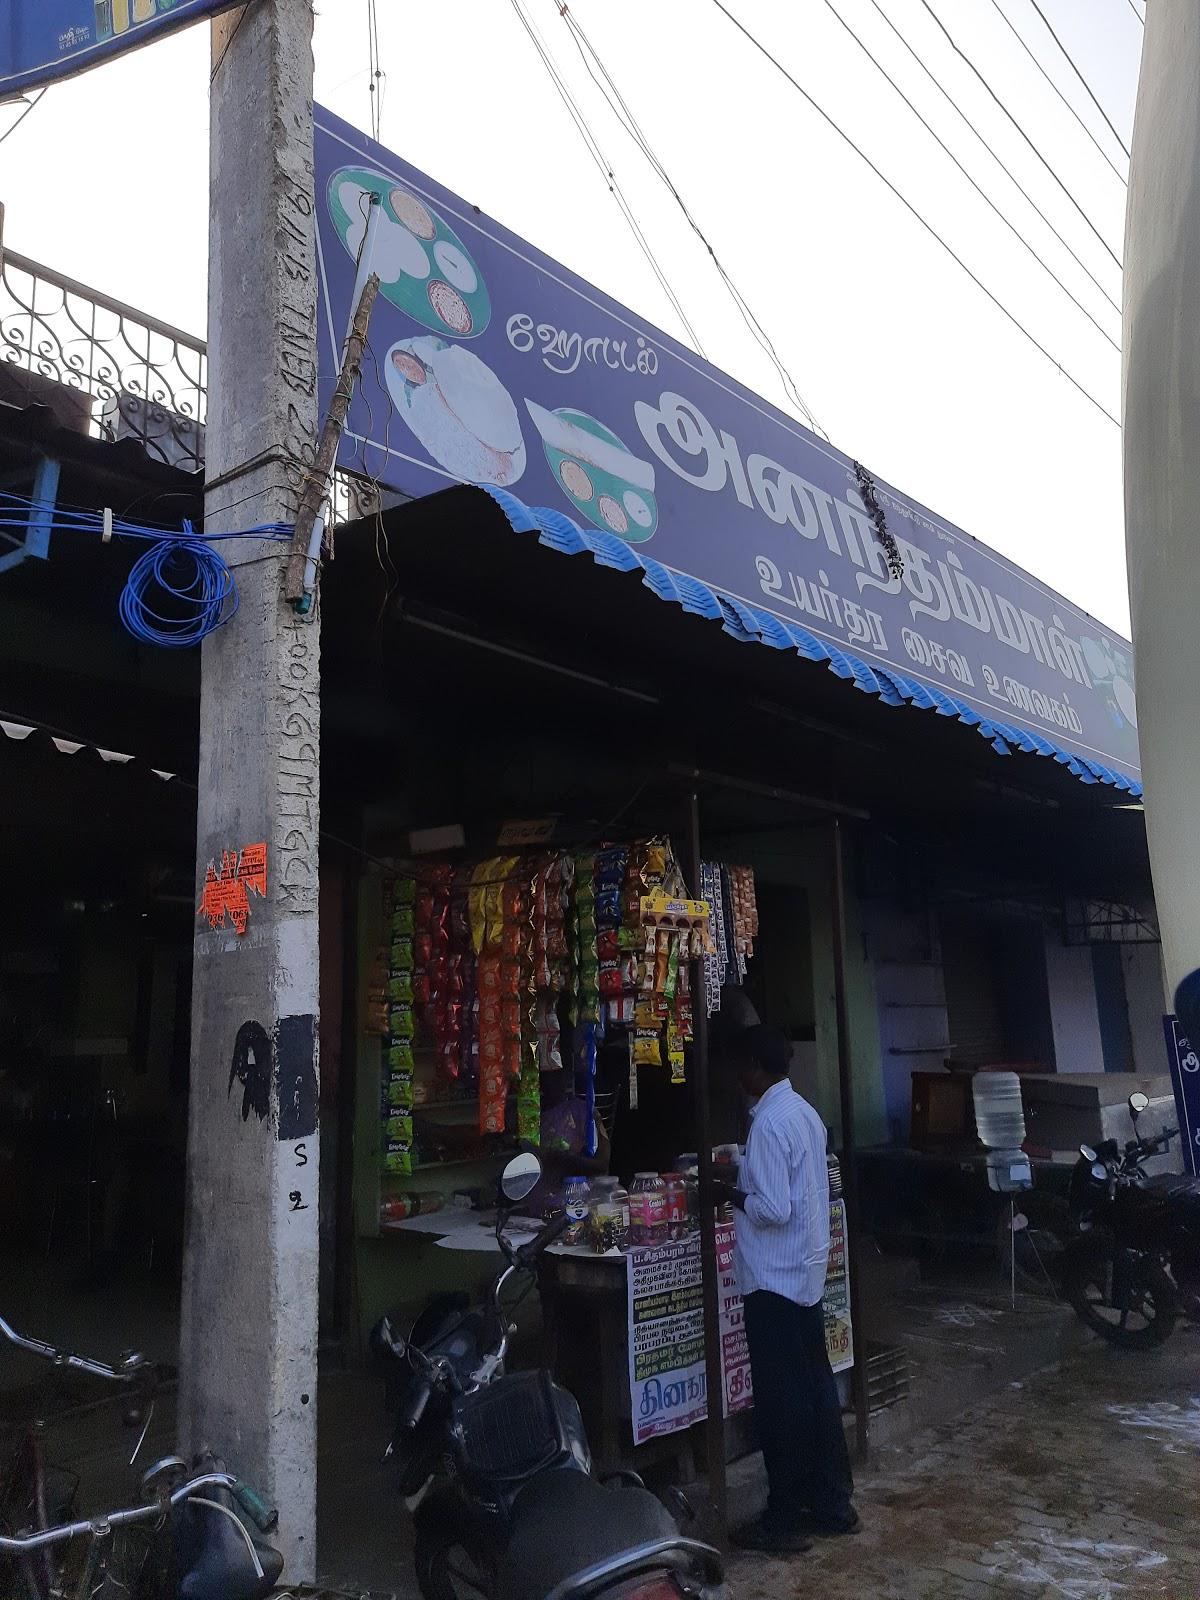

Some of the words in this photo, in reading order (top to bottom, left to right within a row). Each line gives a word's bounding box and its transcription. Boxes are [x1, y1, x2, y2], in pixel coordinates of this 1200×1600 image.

[506, 313, 659, 375] ஹோட்டல்
[755, 555, 888, 651] உயர்தர
[901, 627, 975, 687] சைவ
[981, 664, 1083, 735] உணவகம்
